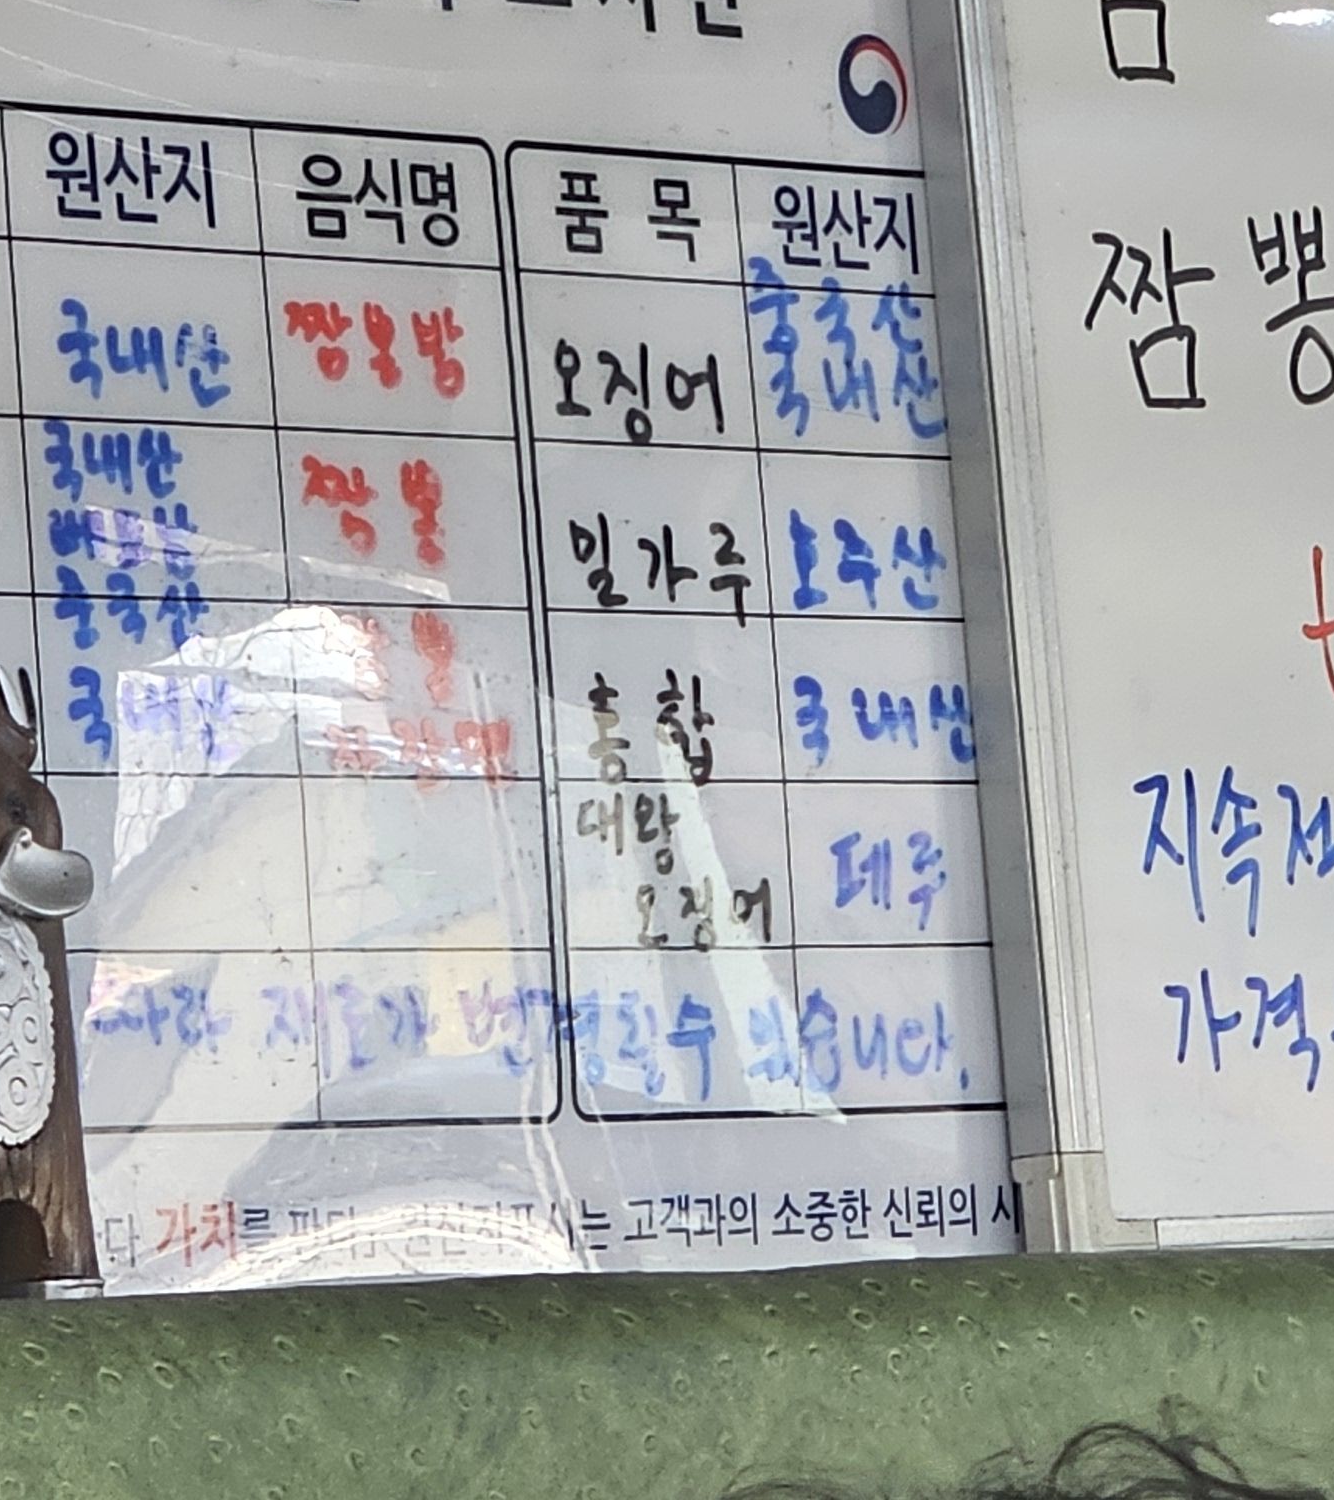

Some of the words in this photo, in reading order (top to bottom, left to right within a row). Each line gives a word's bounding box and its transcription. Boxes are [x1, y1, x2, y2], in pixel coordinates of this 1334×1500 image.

[46, 131, 216, 229] 원산지
[296, 154, 459, 247] 음식명
[771, 185, 919, 274] 원산지
[57, 299, 230, 408] 국내산
[554, 338, 724, 444] 오징어
[43, 418, 184, 502] 국내산
[569, 512, 751, 628] 밀가루
[588, 668, 715, 786] 홍합
[624, 1190, 760, 1248] 고객과의
[772, 1185, 872, 1243] 소중한
[883, 1181, 980, 1239] 신뢰의
